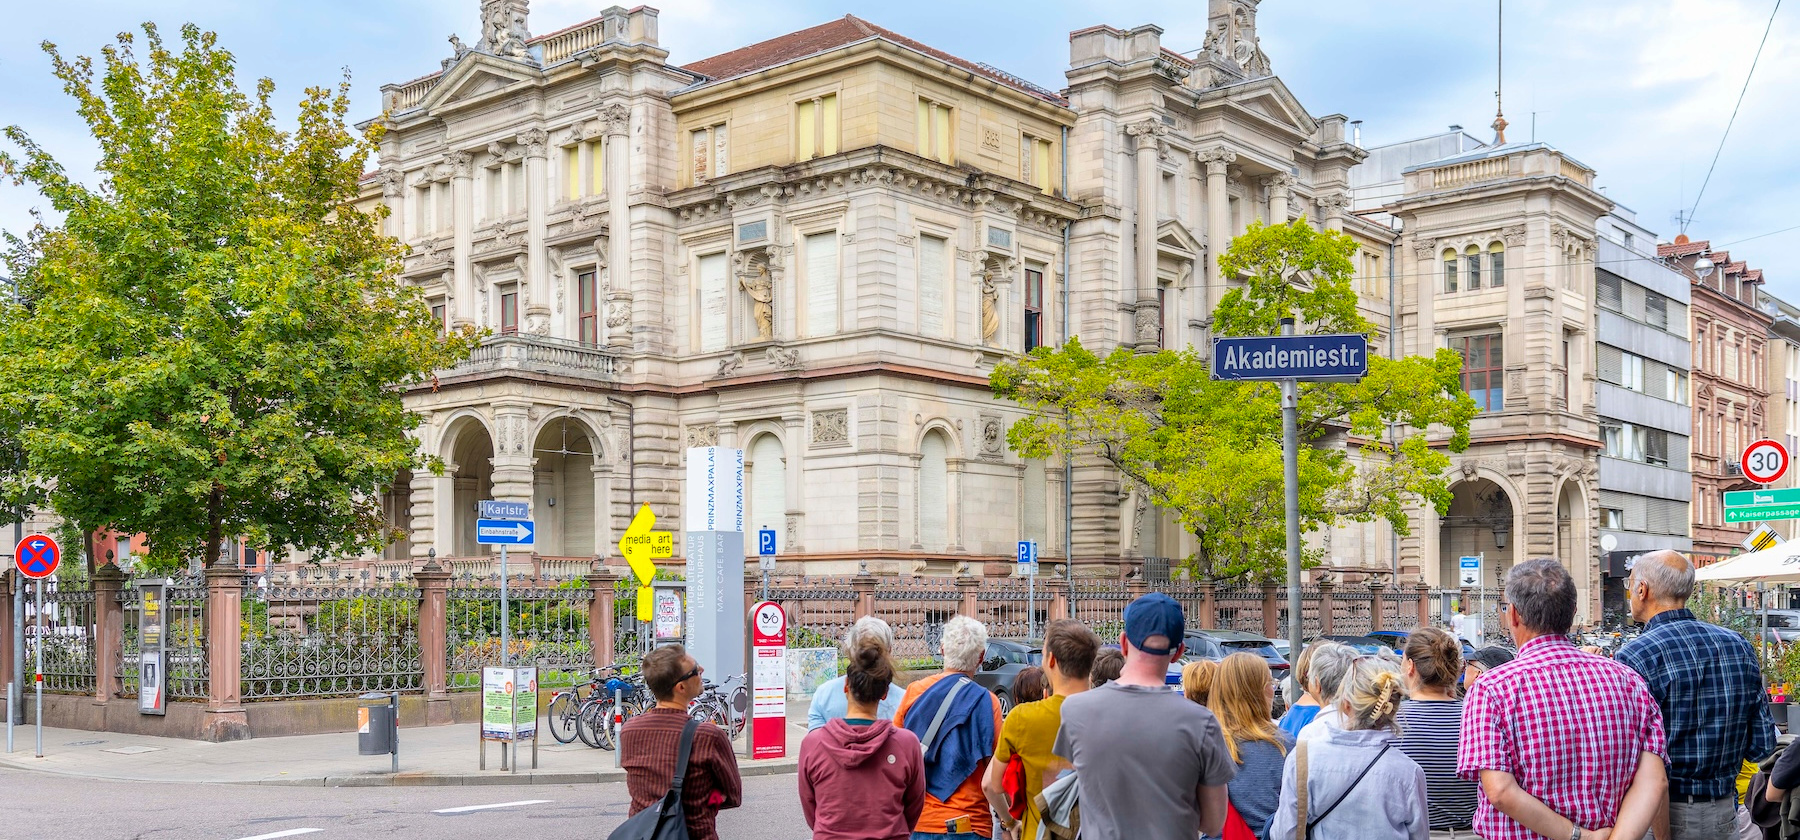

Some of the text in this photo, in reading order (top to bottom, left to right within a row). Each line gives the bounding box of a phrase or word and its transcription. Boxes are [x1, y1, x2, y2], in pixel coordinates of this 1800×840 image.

[1223, 343, 1360, 370] Akademiestr.
[1752, 451, 1779, 472] 30
[487, 503, 526, 516] Karlstr.
[1739, 509, 1800, 519] Kaiserpassage
[480, 528, 519, 536] Einbahnstraße
[625, 534, 671, 545] media art
[761, 532, 772, 553] P
[625, 544, 671, 555] is here
[687, 535, 695, 584] LITERATUR
[658, 595, 676, 604] Prinz-
[656, 613, 680, 623] Palais
[687, 606, 695, 650] MUSEUM
